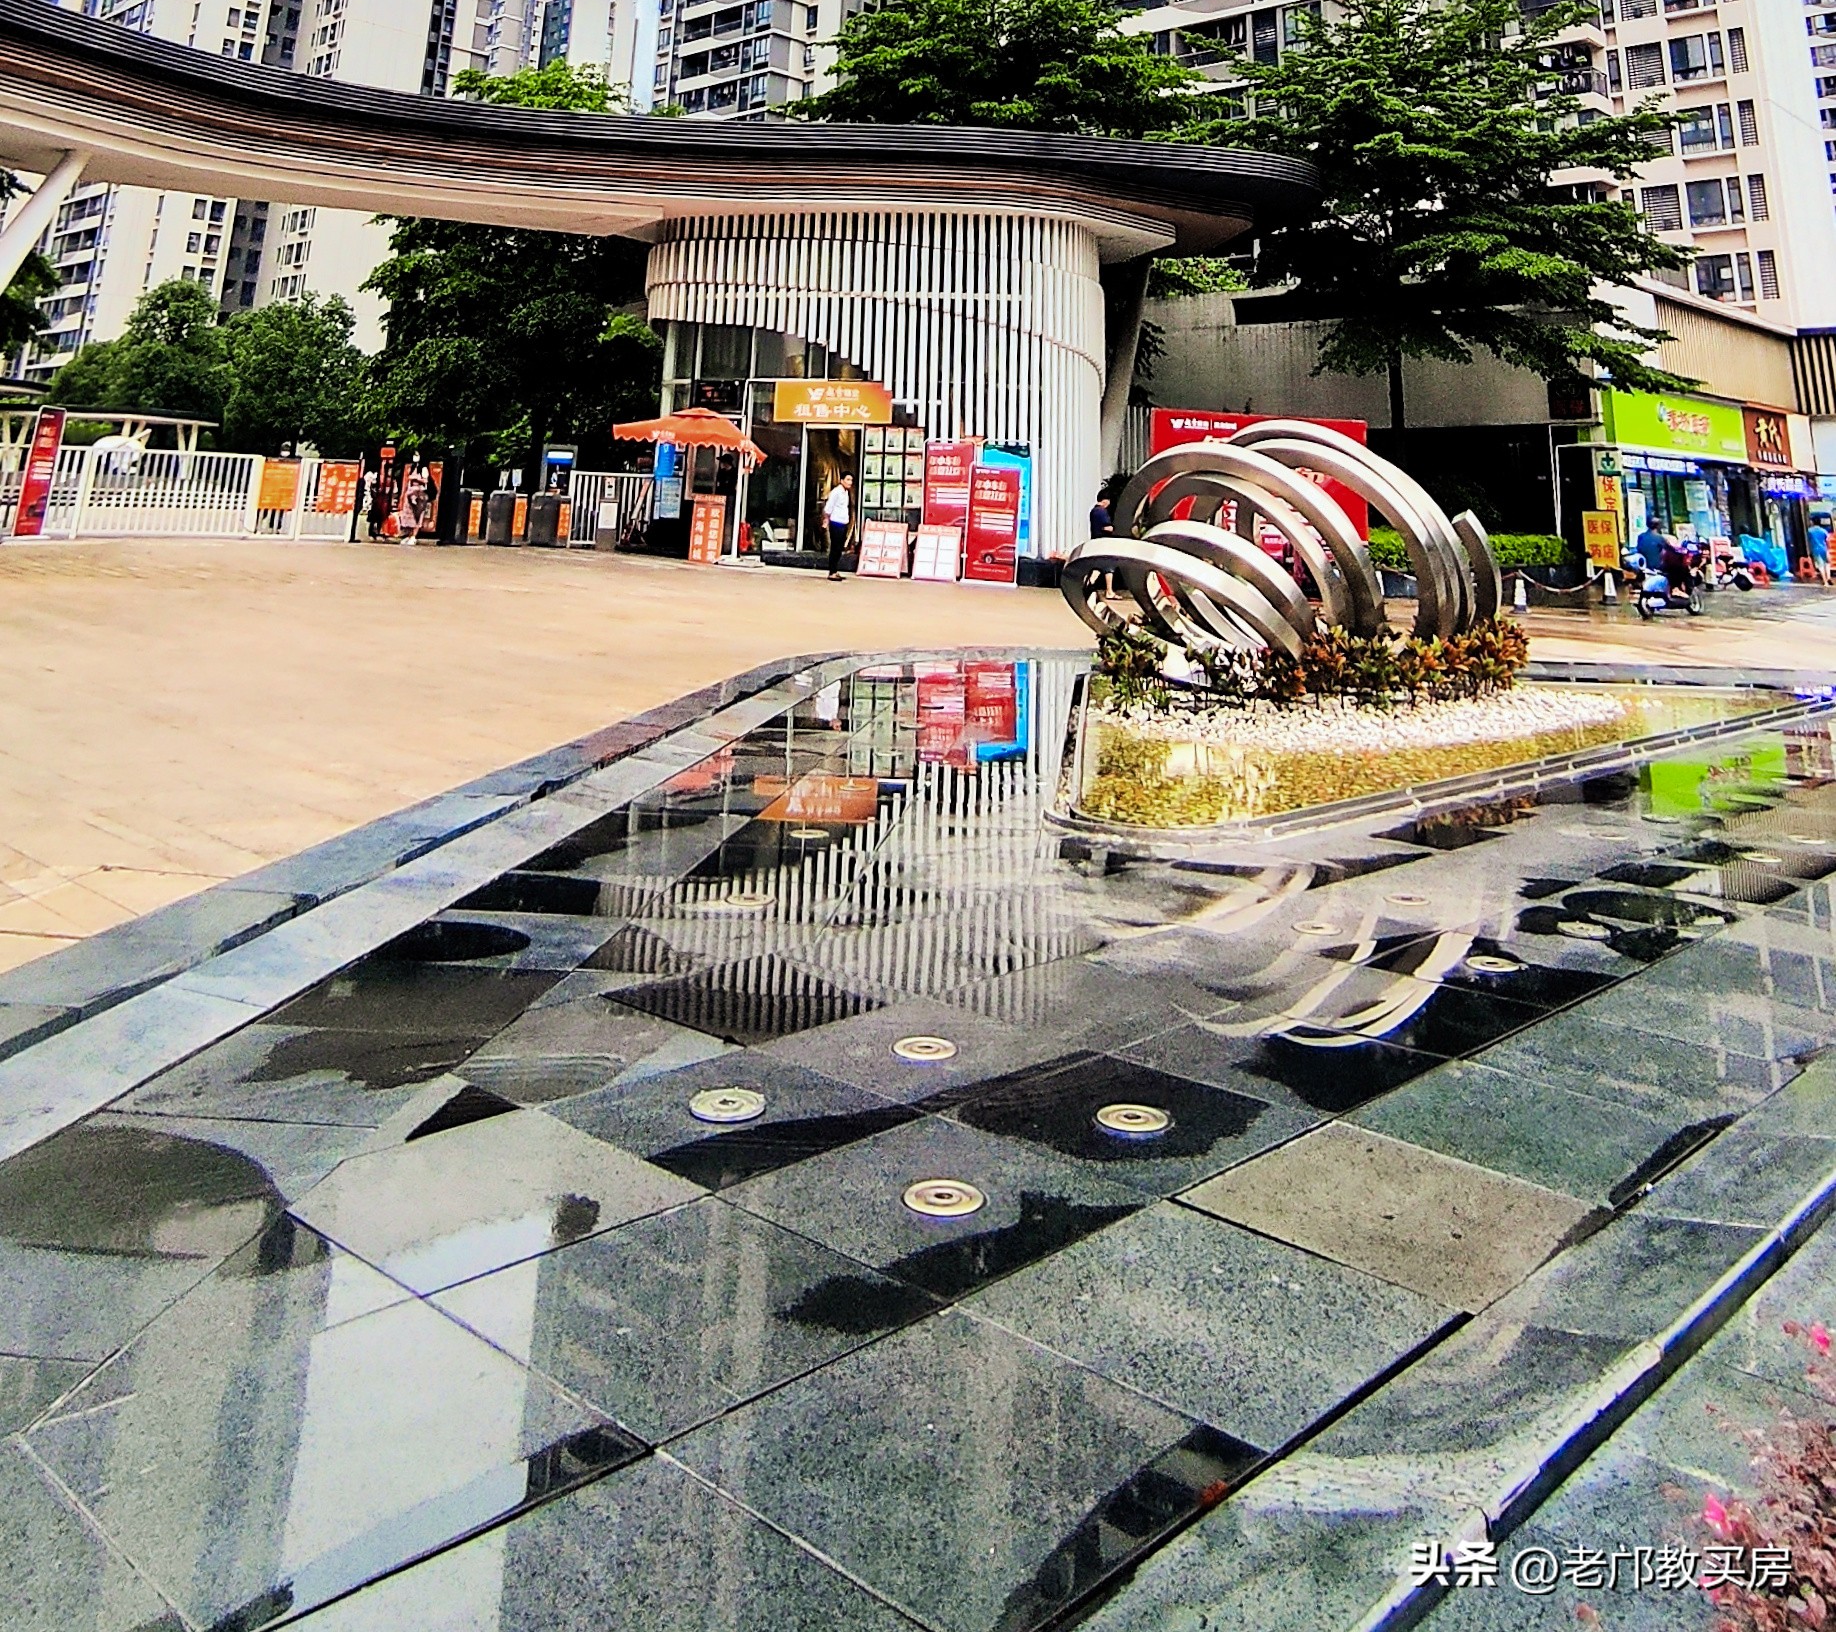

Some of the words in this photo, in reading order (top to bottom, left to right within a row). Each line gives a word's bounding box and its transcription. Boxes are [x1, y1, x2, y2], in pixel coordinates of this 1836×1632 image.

[793, 402, 872, 419] 租售中心
[1586, 519, 1613, 535] 医保
